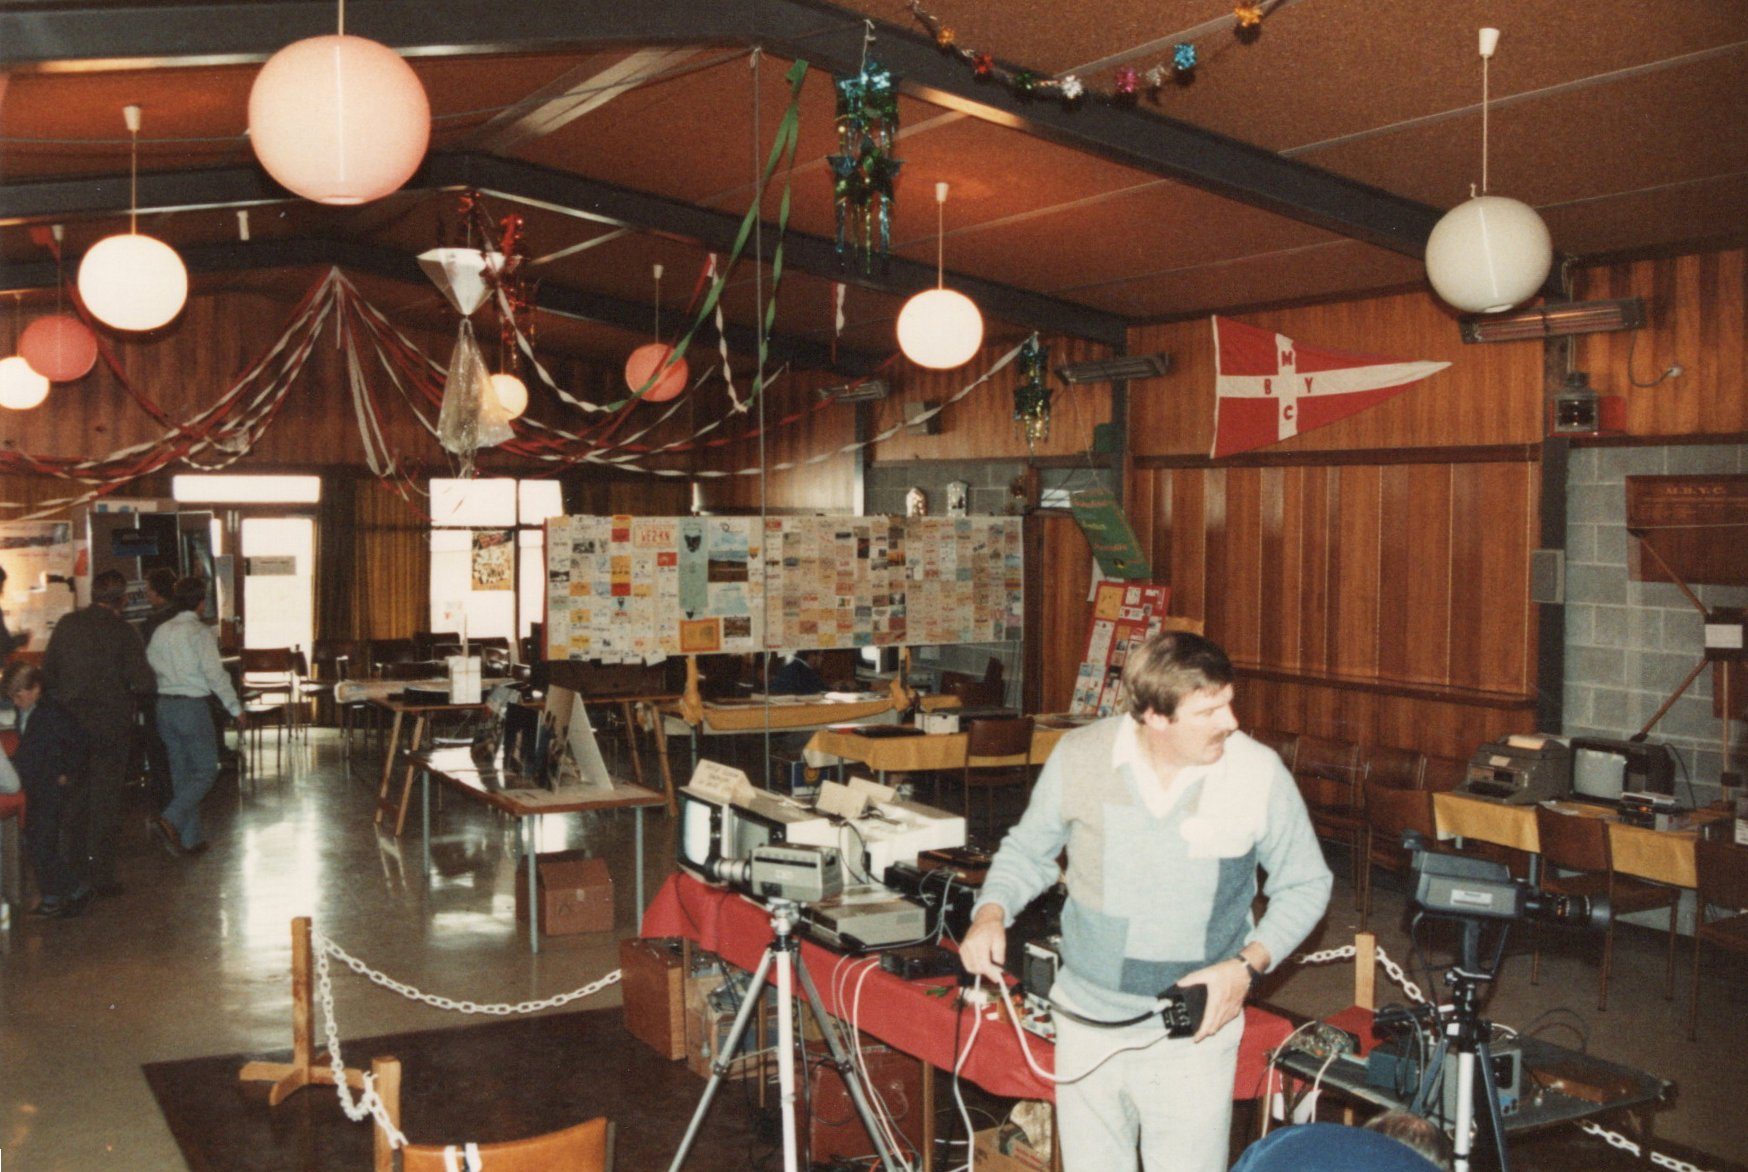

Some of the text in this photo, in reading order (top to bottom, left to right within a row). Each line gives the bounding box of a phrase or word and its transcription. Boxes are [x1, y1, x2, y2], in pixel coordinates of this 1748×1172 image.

[1282, 351, 1292, 366] M
[1264, 377, 1314, 394] B Y
[1283, 405, 1293, 420] C
